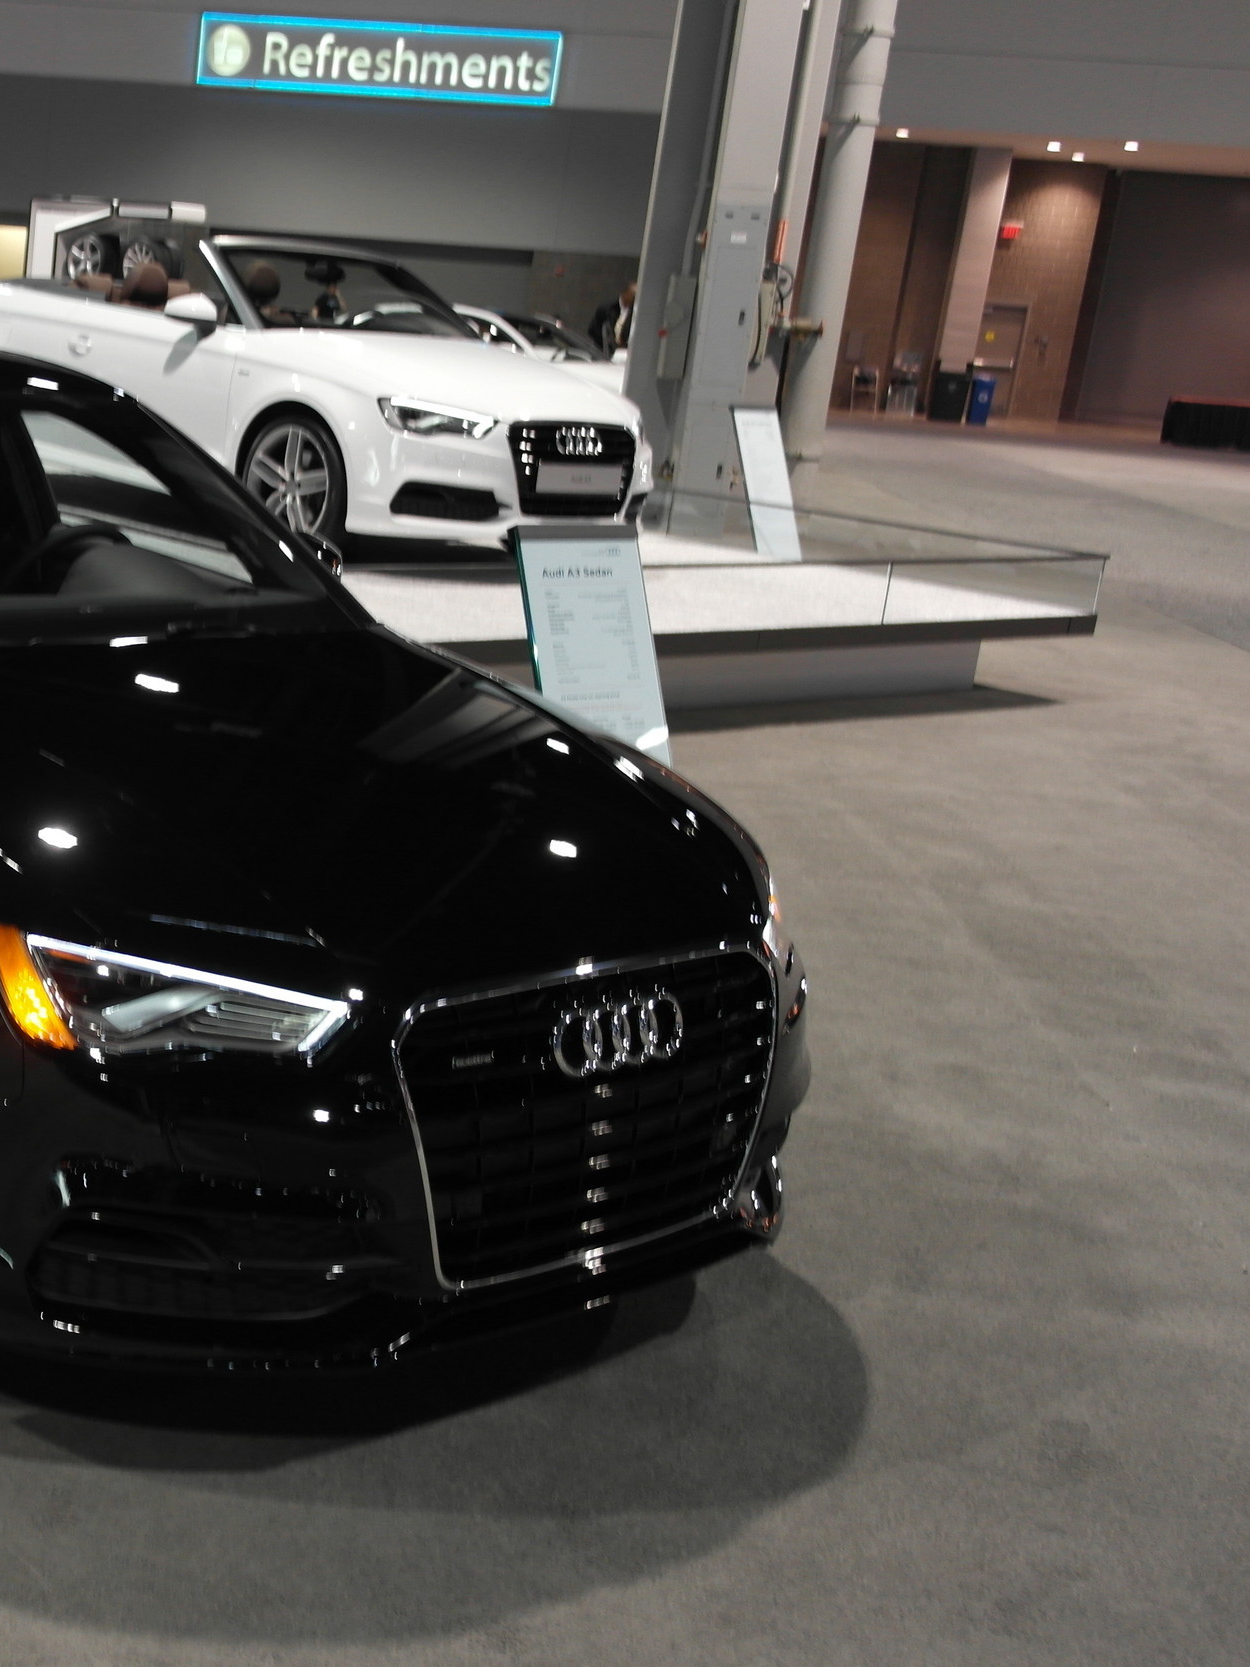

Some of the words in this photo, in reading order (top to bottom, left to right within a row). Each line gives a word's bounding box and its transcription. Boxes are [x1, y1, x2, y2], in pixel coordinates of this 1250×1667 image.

[263, 31, 551, 92] Refreshments
[542, 566, 564, 579] Audi
[567, 567, 580, 578] A3
[583, 566, 613, 578] Sedan
